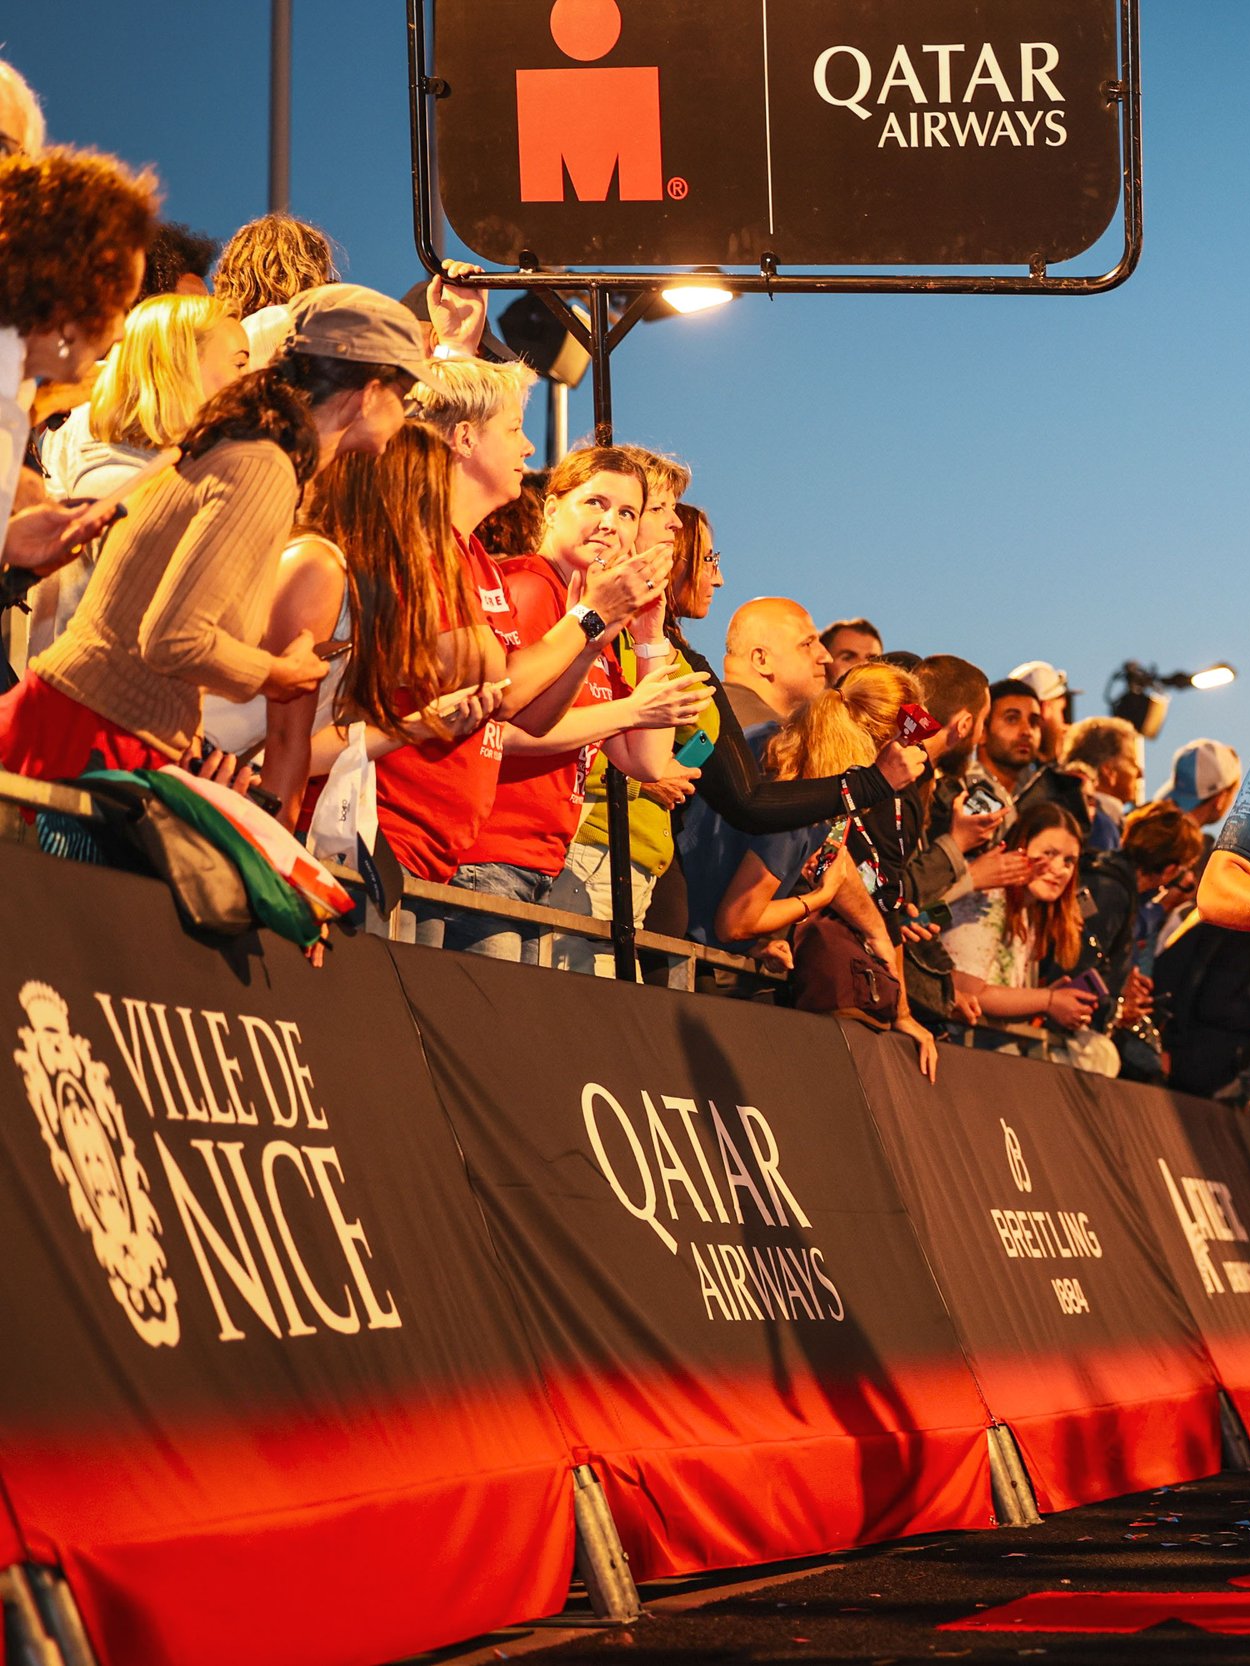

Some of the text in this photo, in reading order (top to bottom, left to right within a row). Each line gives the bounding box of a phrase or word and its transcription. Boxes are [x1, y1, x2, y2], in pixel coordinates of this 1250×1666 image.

[812, 42, 1066, 119] QATAR
[877, 110, 1068, 148] AIRWAYS
[94, 992, 328, 1130] VILLE DE
[580, 1082, 813, 1255] QATAR
[154, 1131, 402, 1342] NICE
[990, 1209, 1102, 1258] BREITLING
[690, 1241, 845, 1322] AIRWAYS
[1051, 1278, 1090, 1314] 1884
